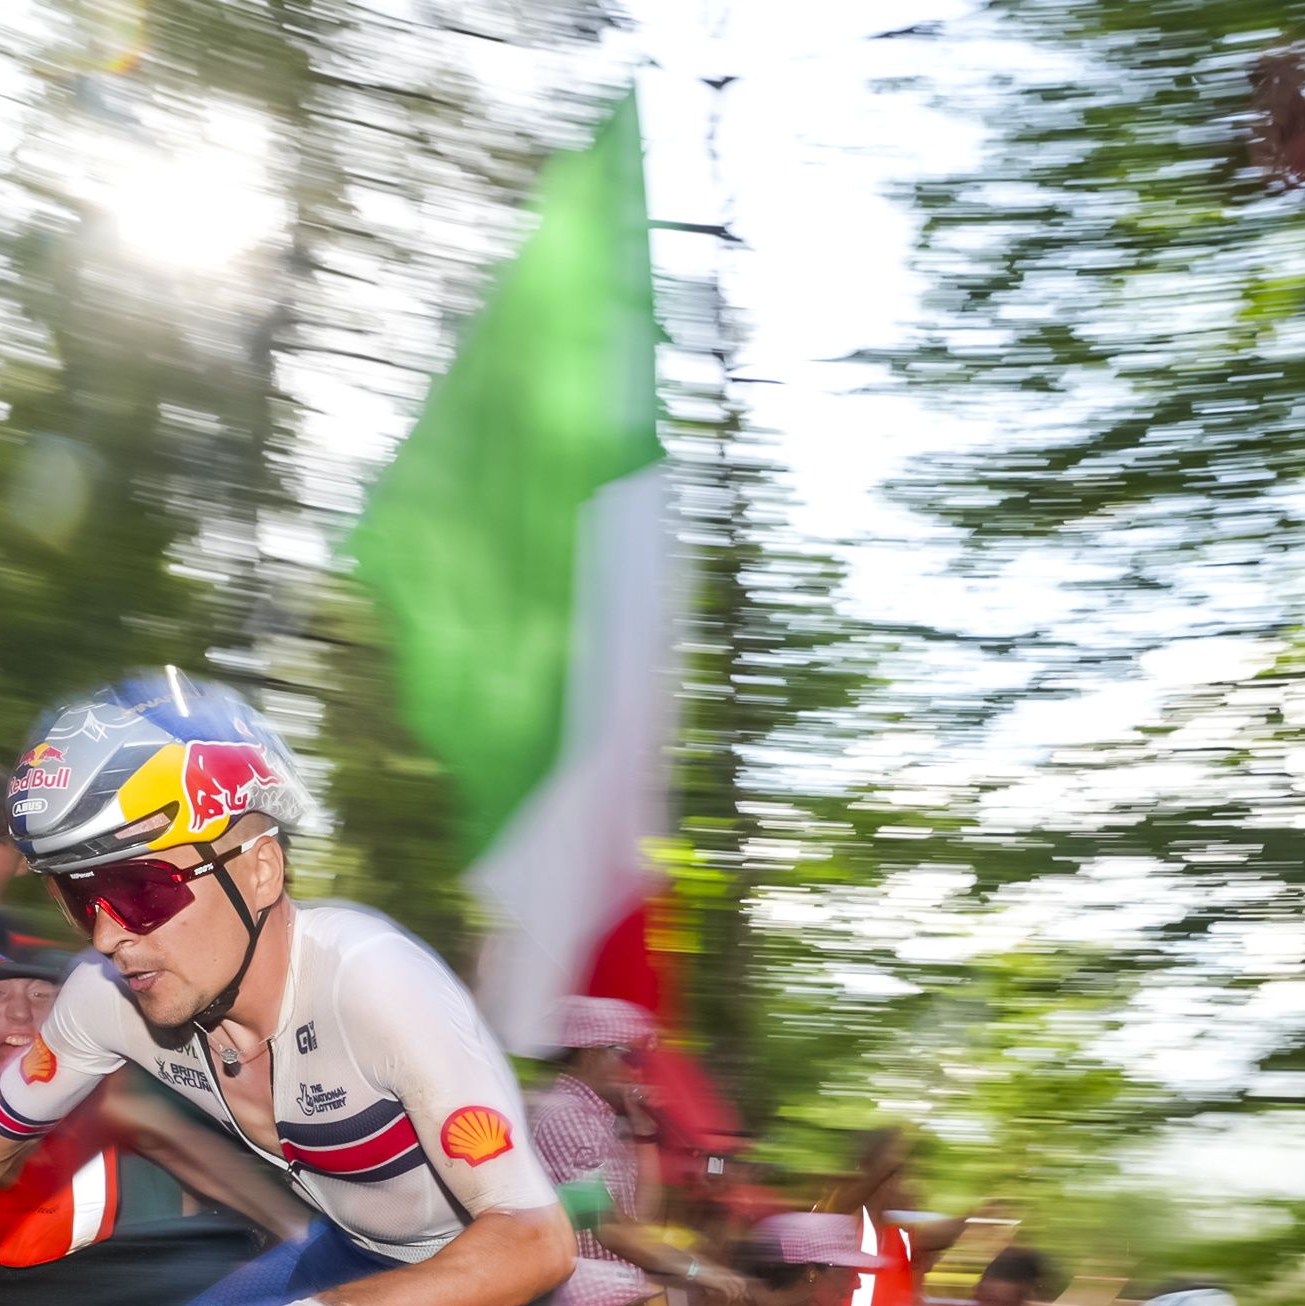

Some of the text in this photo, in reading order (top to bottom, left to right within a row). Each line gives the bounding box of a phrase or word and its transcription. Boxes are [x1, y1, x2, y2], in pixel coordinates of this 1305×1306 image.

[30, 767, 71, 789] Bull
[15, 801, 43, 814] ABUS
[170, 1063, 208, 1082] BRITIS
[173, 1075, 215, 1094] CYCLIN
[310, 1083, 323, 1093] THE
[313, 1086, 347, 1103] NATIONAL
[315, 1096, 346, 1113] LOTTERY
